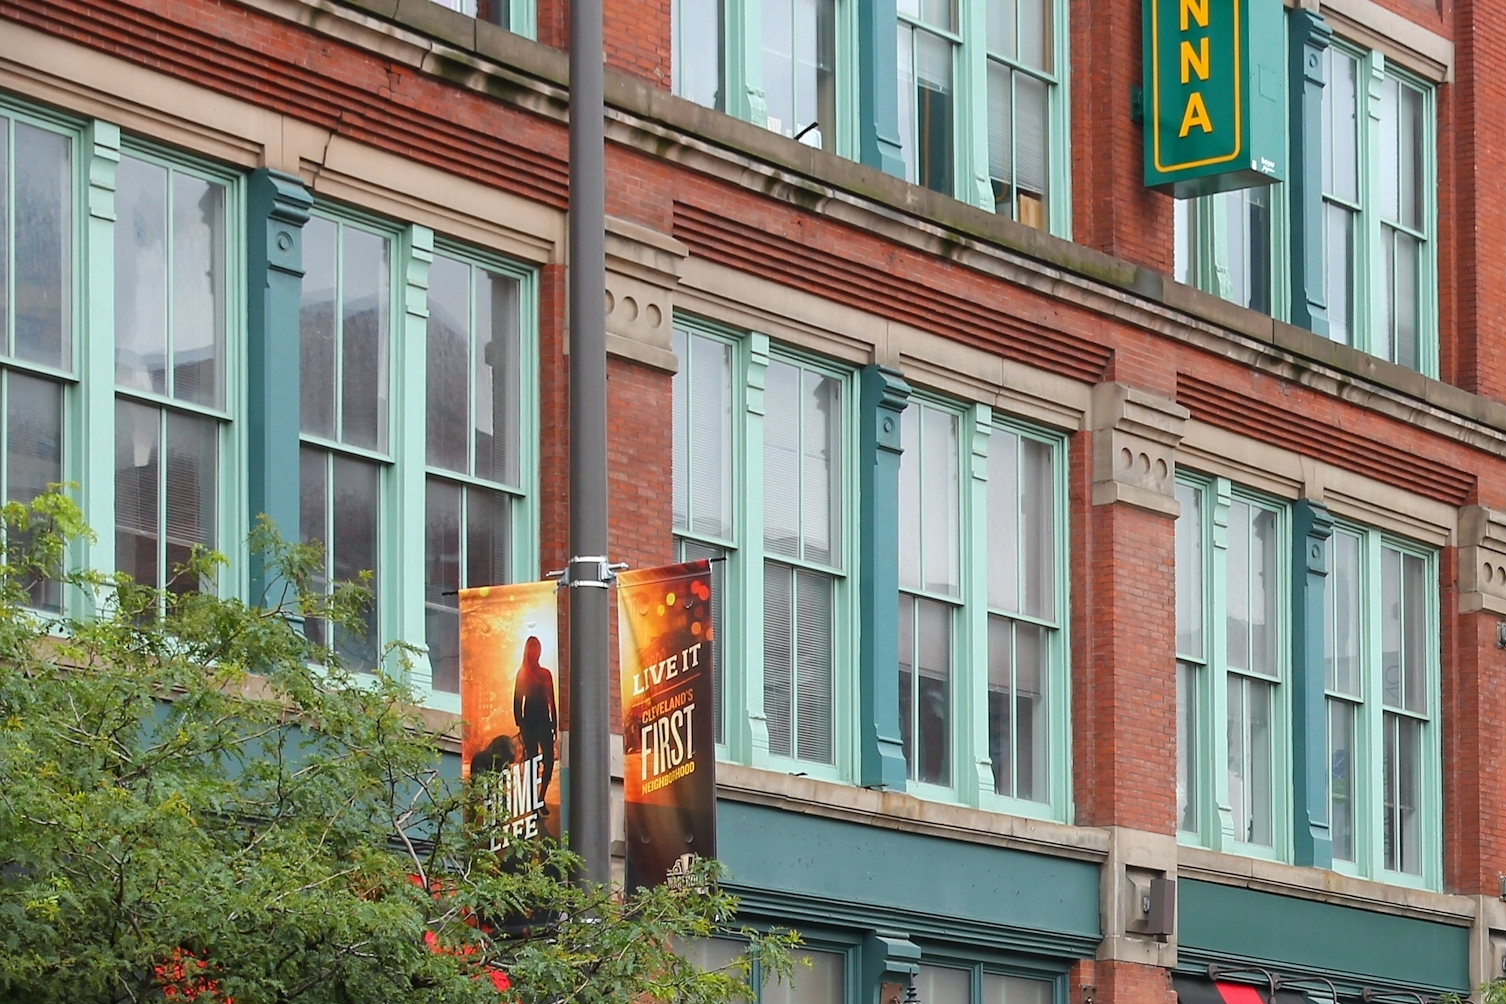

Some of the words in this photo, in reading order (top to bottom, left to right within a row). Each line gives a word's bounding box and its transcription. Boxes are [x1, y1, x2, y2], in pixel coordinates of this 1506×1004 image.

[632, 655, 679, 697] LIVE
[682, 642, 702, 672] IT
[642, 688, 694, 724] CLEVELAND'S
[641, 703, 695, 782] FIRST
[641, 761, 695, 796] NEIGHBORHOOD
[489, 813, 538, 853] LIFE
